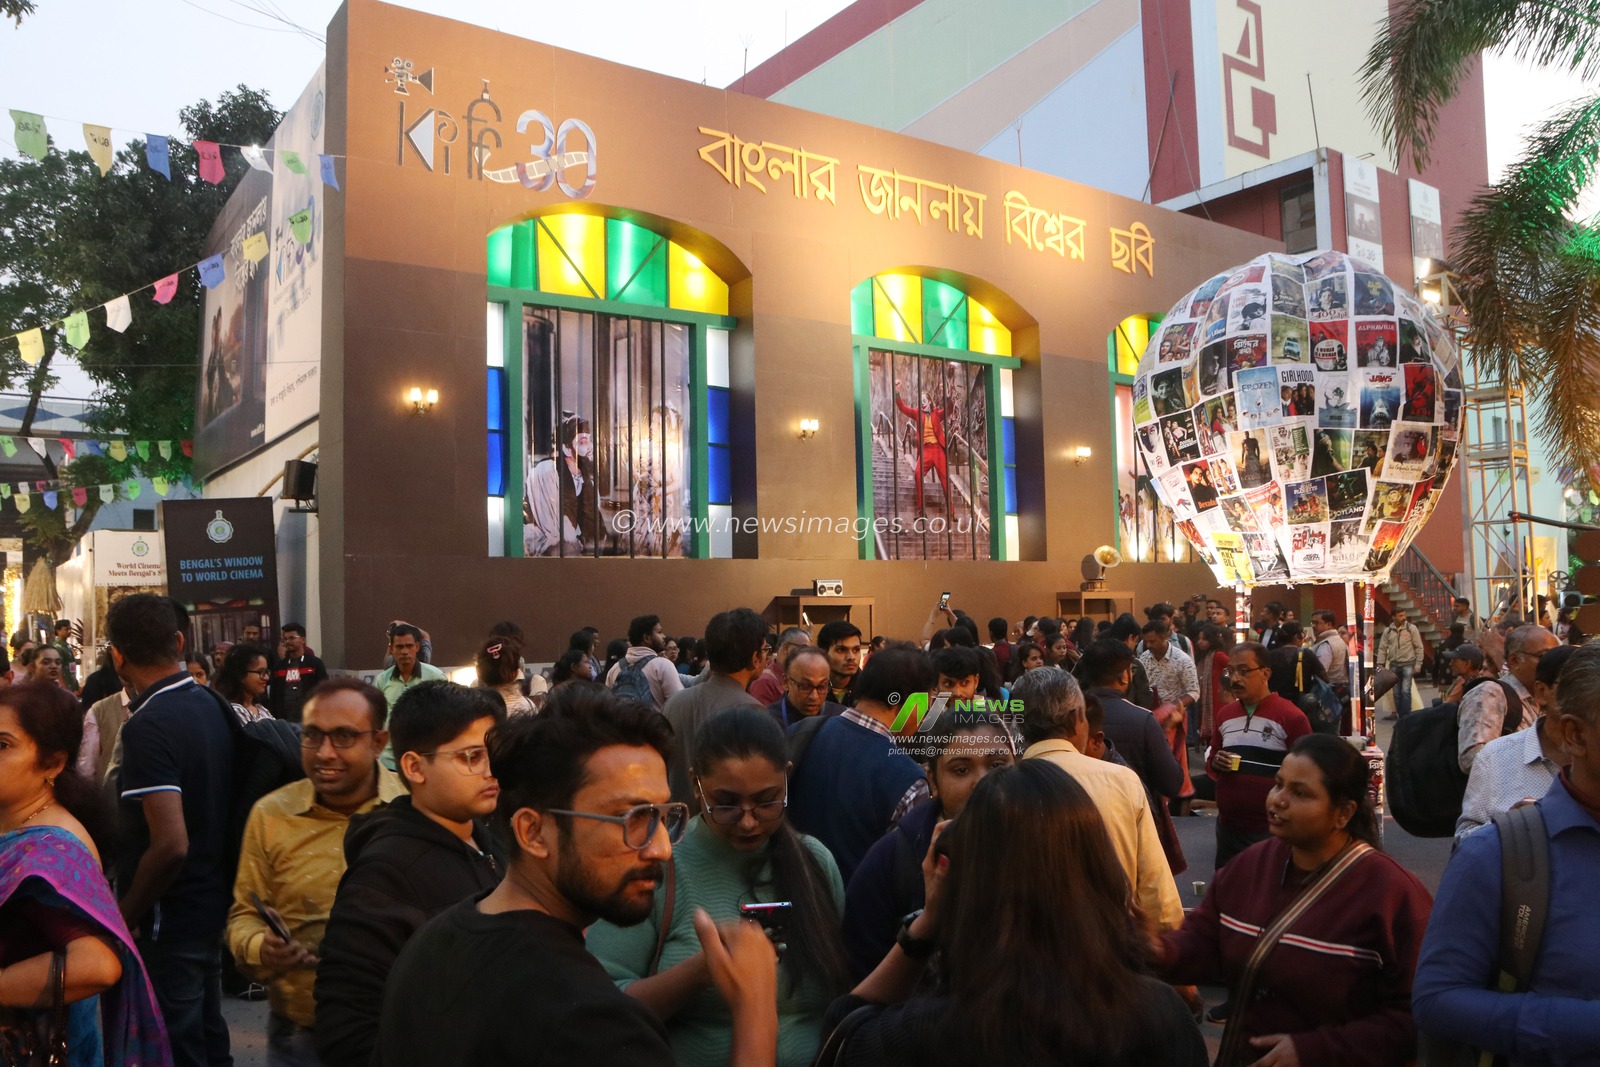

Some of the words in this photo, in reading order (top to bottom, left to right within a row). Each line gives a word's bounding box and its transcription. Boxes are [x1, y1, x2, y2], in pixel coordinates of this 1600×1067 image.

[698, 126, 841, 206] বাংলার
[857, 164, 987, 239] জানলায়
[1003, 190, 1087, 262] বিশ্বের
[1109, 221, 1156, 277] ছবি
[1281, 370, 1315, 383] GIRLHOOD
[1369, 374, 1393, 383] JAWS
[1241, 381, 1277, 393] FROZEN
[1332, 505, 1366, 519] JOYLAND
[224, 556, 264, 567] WINDOW
[1224, 558, 1237, 568] BILL
[181, 572, 193, 582] TO
[196, 571, 228, 582] WORLD
[230, 569, 264, 580] CINEMA
